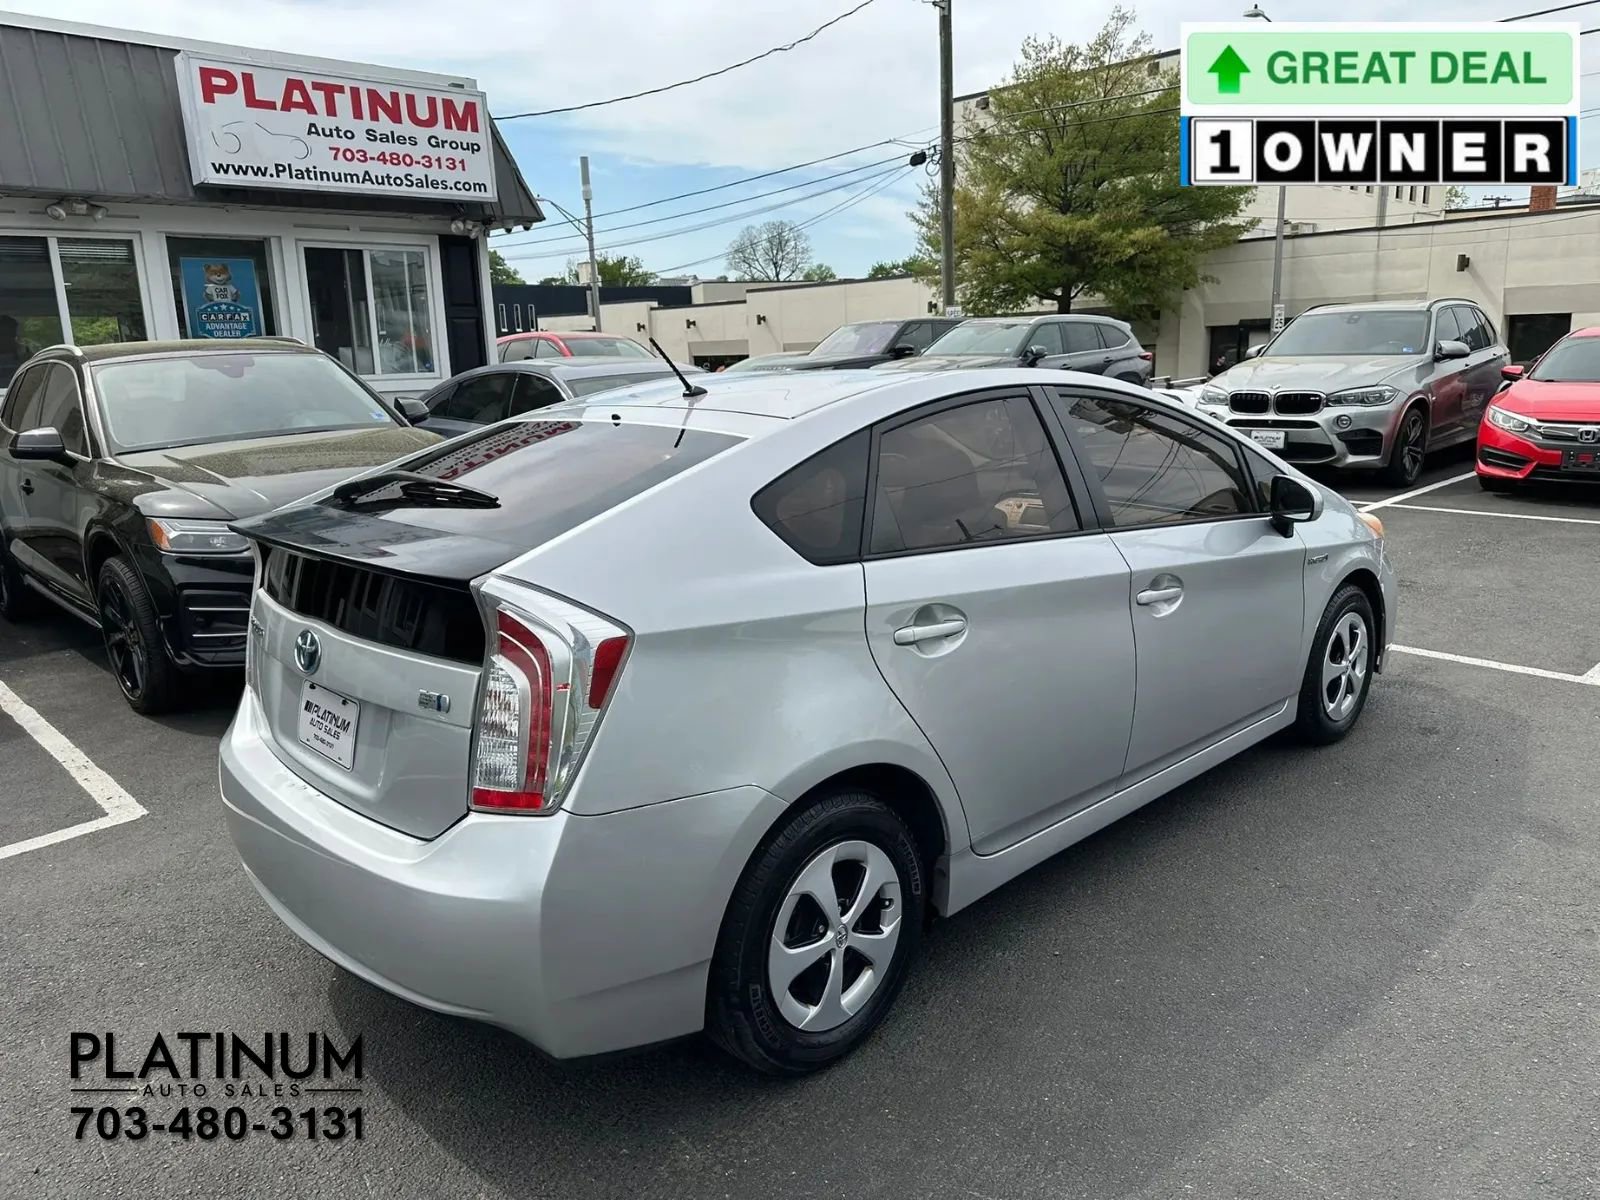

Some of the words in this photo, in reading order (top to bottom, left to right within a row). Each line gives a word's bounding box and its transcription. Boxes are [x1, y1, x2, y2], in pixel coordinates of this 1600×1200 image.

[199, 66, 479, 133] PLATINUM
[307, 122, 355, 140] Auto
[365, 128, 418, 147] Sales
[427, 134, 481, 154] Group
[328, 146, 467, 172] 703-480-3131
[211, 161, 488, 194] www.PlatinumAutoSales.com
[201, 312, 249, 321] CARFAX
[206, 322, 248, 330] ADVANTAGE
[1274, 318, 1283, 329] 25
[309, 717, 323, 731] AUTO
[323, 725, 341, 741] SALES
[312, 703, 351, 734] PLATINUM
